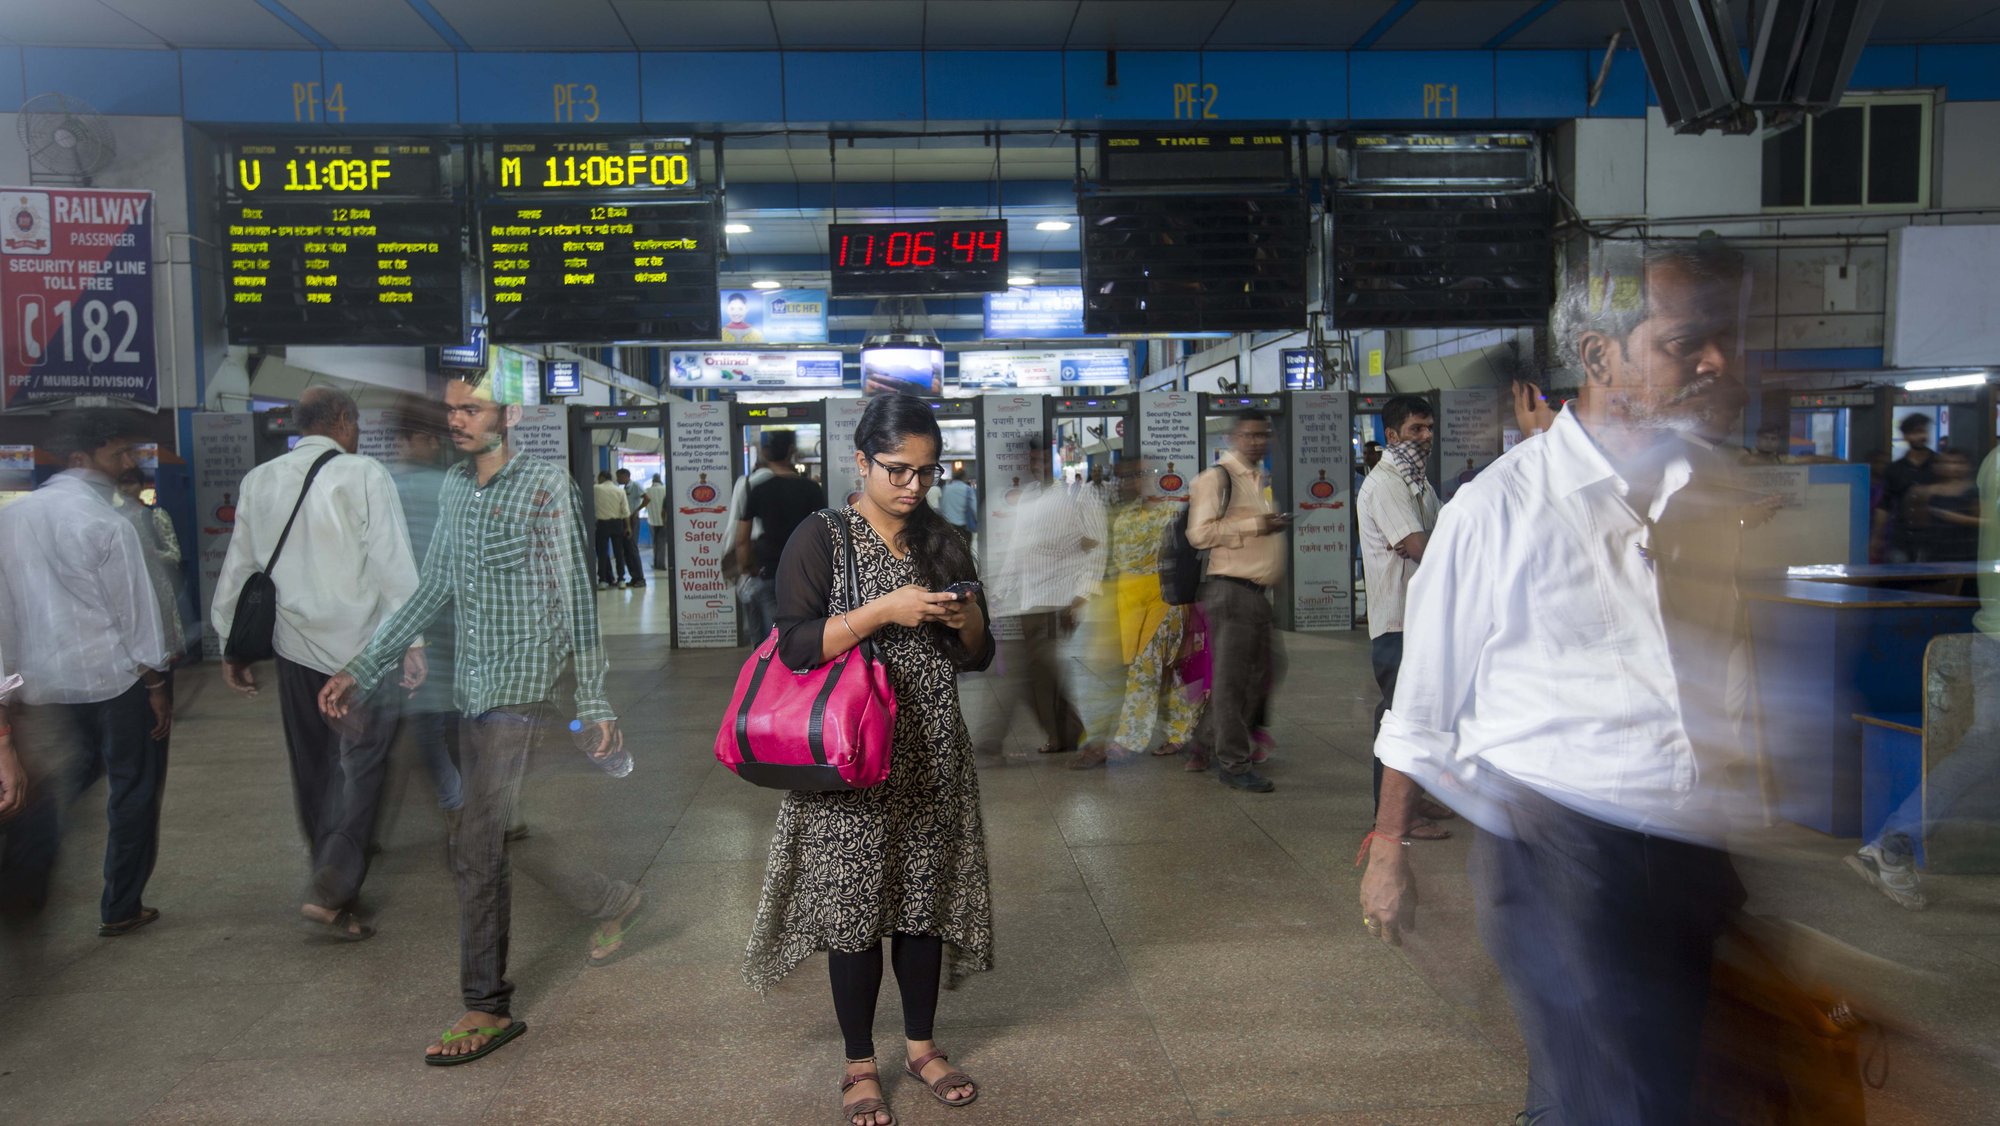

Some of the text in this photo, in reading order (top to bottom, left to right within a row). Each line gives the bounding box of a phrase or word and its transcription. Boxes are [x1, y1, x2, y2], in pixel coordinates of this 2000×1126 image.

[293, 81, 347, 122] PF-4
[554, 83, 600, 122] PF-3
[1174, 83, 1219, 119] PF-2
[1424, 84, 1457, 118] PF-1
[553, 143, 609, 151] TIME
[1404, 137, 1456, 145] TIME
[295, 146, 352, 154] TIME
[501, 157, 521, 187] M
[55, 197, 147, 225] RAILWAY
[332, 208, 348, 222] 12
[590, 207, 606, 220] 12
[70, 232, 135, 247] PASSENGER
[839, 232, 1002, 266] 11:06:44
[9, 259, 147, 275] SECURITY HELP LINE
[44, 276, 114, 291] TOLL FREE
[786, 303, 820, 313] LIC HFL
[54, 299, 140, 363] 182
[704, 356, 749, 365] Online!
[9, 375, 31, 387] RPF
[33, 376, 40, 388] /
[43, 376, 90, 387] MUMBAI
[92, 376, 144, 388] DIVISION
[677, 421, 703, 429] Security
[690, 519, 717, 529] Your
[685, 531, 723, 544] Safety
[699, 544, 710, 554] is
[691, 556, 719, 566] Your
[680, 569, 720, 581] Family
[683, 581, 728, 591] Wealth!
[1298, 596, 1333, 606] Samarth
[681, 610, 719, 620] Samarth
